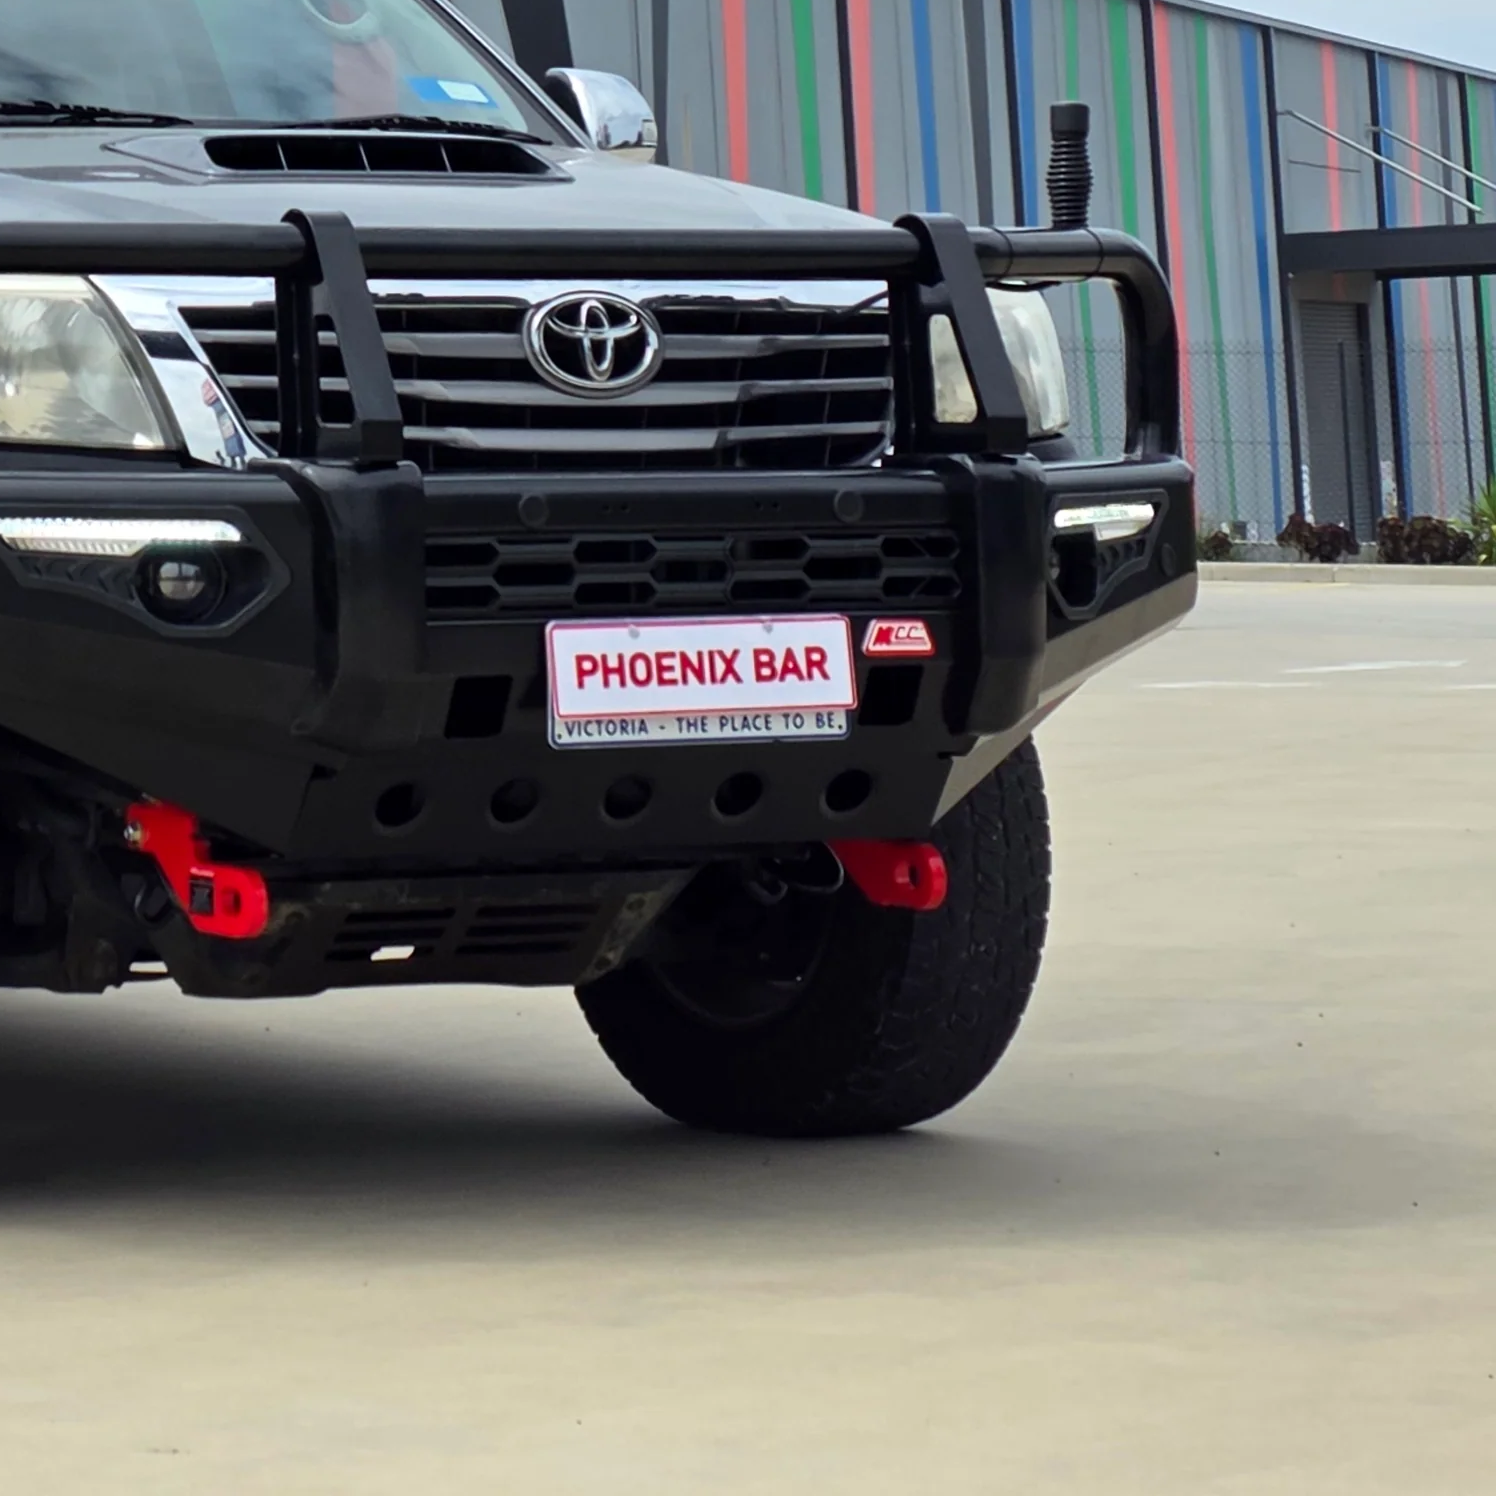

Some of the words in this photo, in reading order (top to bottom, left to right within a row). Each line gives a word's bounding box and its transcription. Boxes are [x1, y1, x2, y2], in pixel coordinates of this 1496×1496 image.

[574, 648, 744, 691] PHOENIX
[753, 646, 831, 683] BAR
[564, 719, 649, 737] VICTORIA
[676, 716, 709, 734] THE
[719, 714, 773, 733] PLACE
[783, 713, 805, 730] TO
